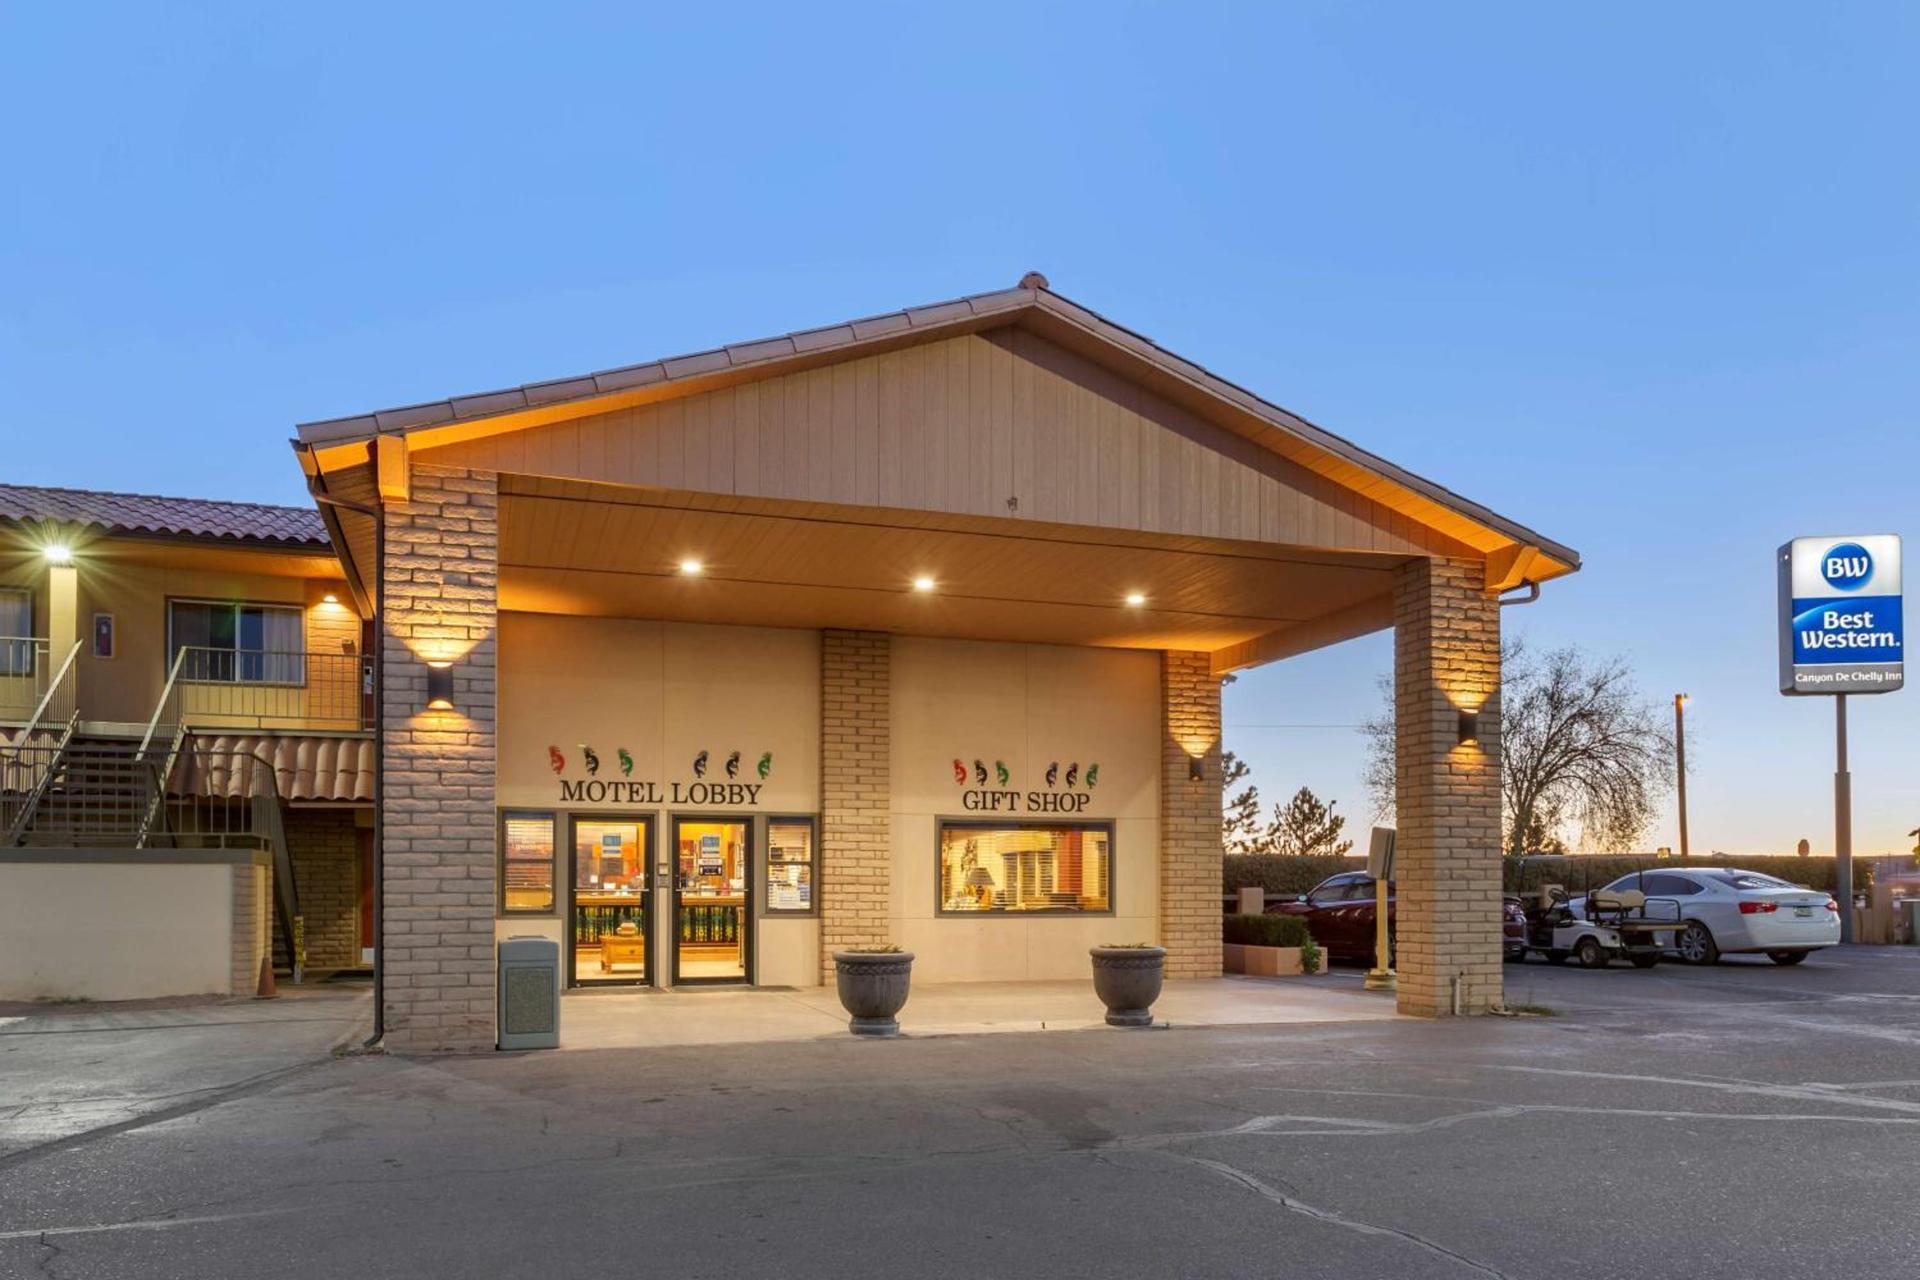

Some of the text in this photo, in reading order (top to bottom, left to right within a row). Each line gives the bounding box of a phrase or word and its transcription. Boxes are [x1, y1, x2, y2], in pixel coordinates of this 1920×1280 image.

[1826, 557, 1868, 578] BW
[1823, 611, 1874, 629] Best
[1795, 671, 1903, 683] Canyon De Chelly Inn
[559, 780, 762, 805] MOTEL LOBBY
[963, 790, 1090, 812] GIFT SHOP
